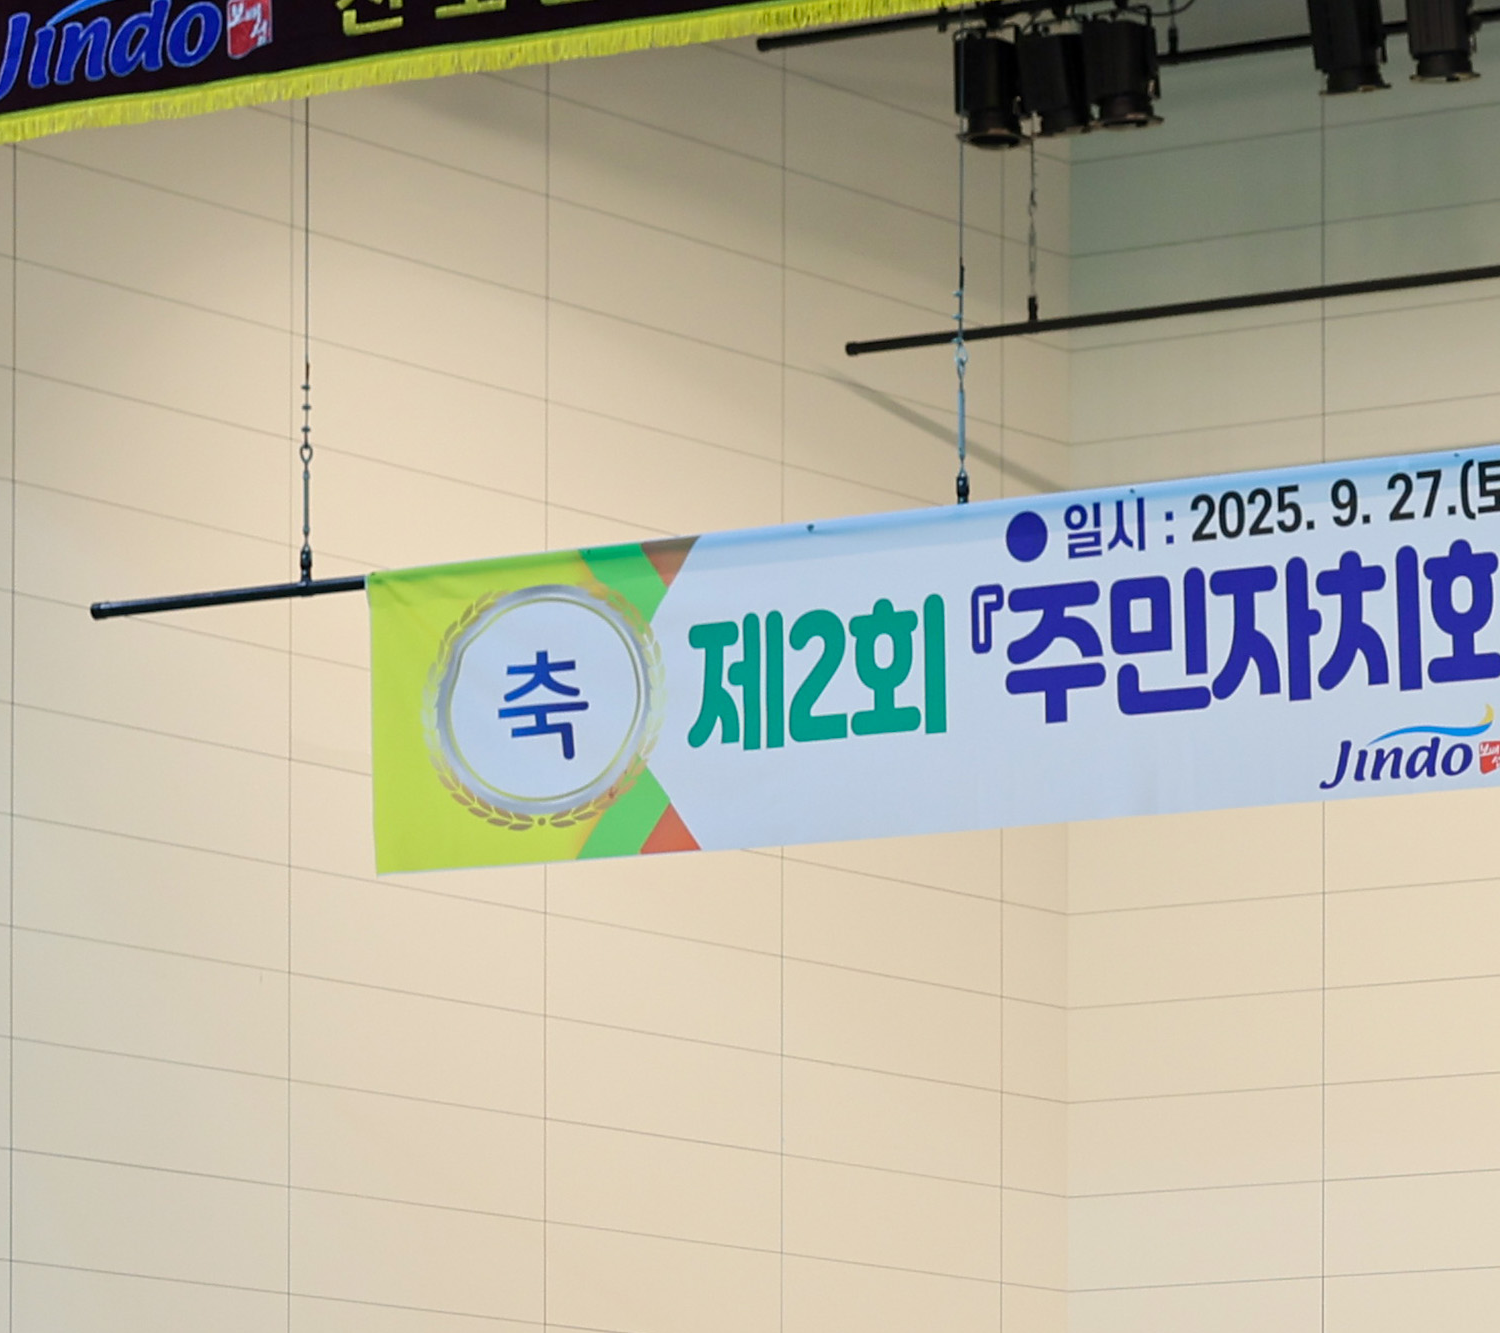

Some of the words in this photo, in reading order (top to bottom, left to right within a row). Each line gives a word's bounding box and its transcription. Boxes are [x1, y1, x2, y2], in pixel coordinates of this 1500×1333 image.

[1064, 496, 1147, 560] 일시
[1190, 484, 1316, 543] 2025.
[1330, 478, 1372, 527] 9.
[497, 649, 591, 760] 축
[687, 593, 948, 751] 제2회
[1319, 735, 1474, 790] Jindo
